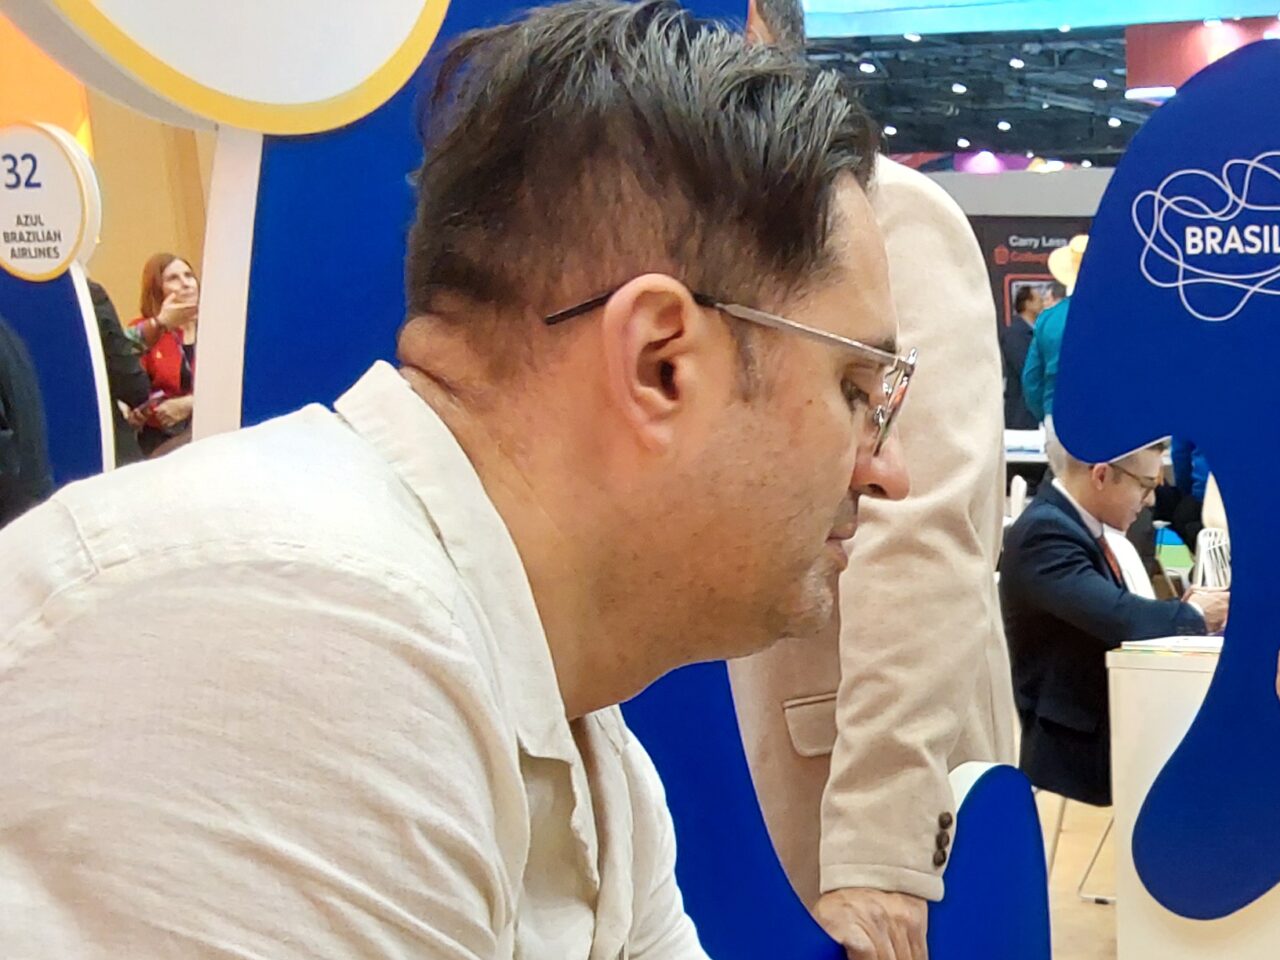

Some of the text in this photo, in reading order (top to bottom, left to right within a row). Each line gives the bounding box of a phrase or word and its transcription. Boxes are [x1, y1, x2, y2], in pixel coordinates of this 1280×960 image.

[1, 153, 42, 189] 32
[16, 214, 45, 227] AZUL
[2, 229, 62, 244] BRAZILIAN
[10, 246, 60, 259] AIRLINES
